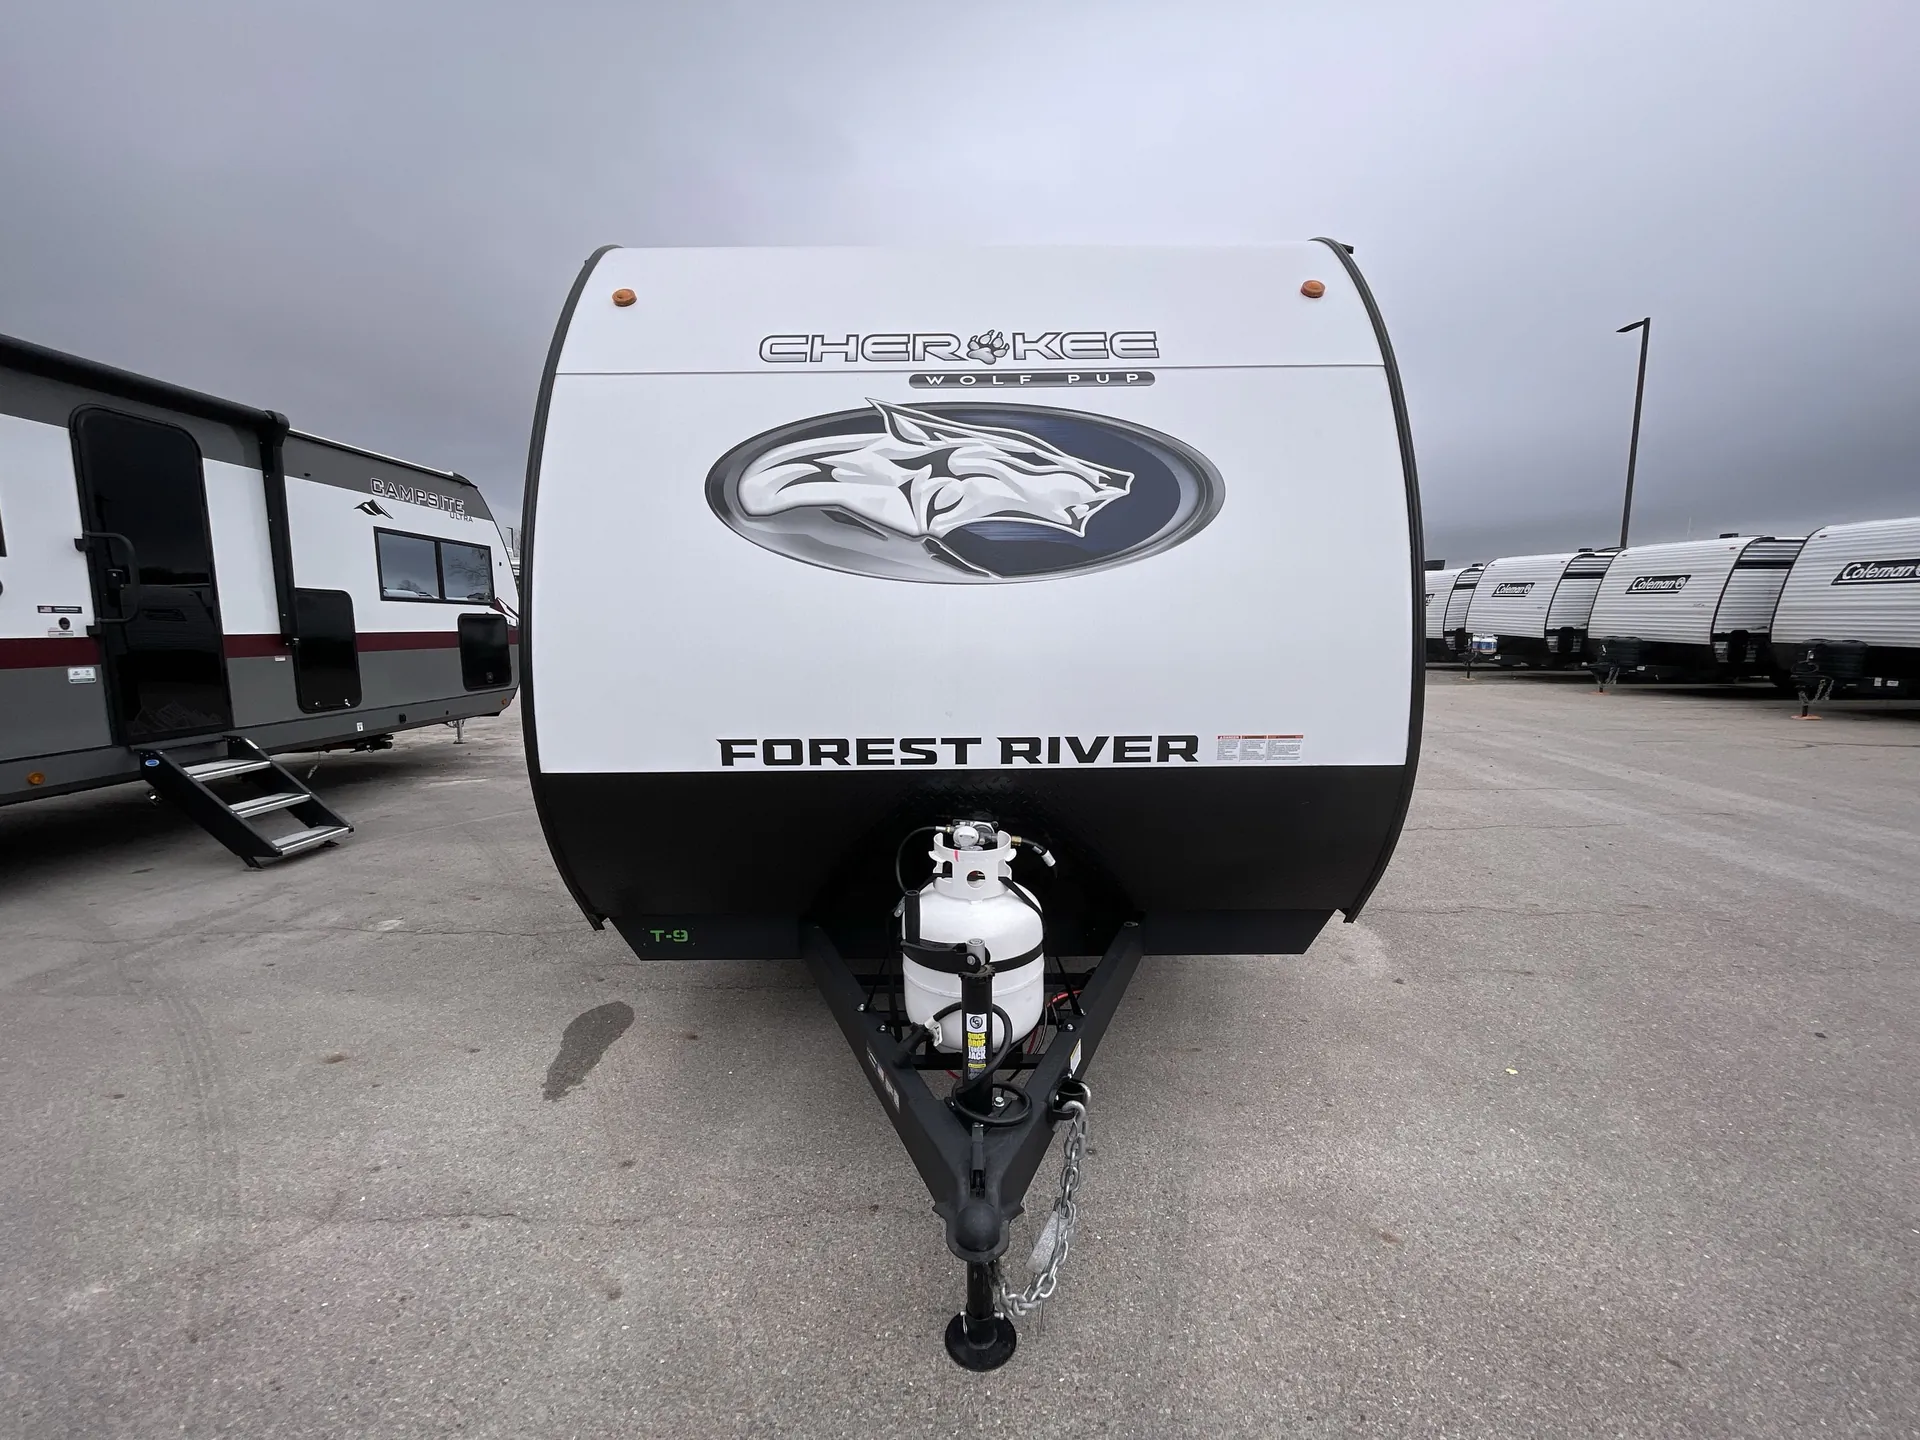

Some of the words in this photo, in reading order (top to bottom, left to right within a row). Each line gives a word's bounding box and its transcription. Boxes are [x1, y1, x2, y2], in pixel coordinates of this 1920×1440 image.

[925, 375, 1032, 386] WOLF
[1067, 373, 1139, 384] PUP
[370, 477, 465, 515] CAMPSITE
[450, 511, 474, 523] ULTRA
[1842, 562, 1916, 580] Coleman
[1495, 583, 1524, 594] Coleman
[1632, 577, 1676, 590] Coleman
[715, 737, 982, 766] FOREST
[997, 735, 1199, 764] RIVER
[650, 930, 689, 942] T-9
[968, 1051, 986, 1060] JACK
